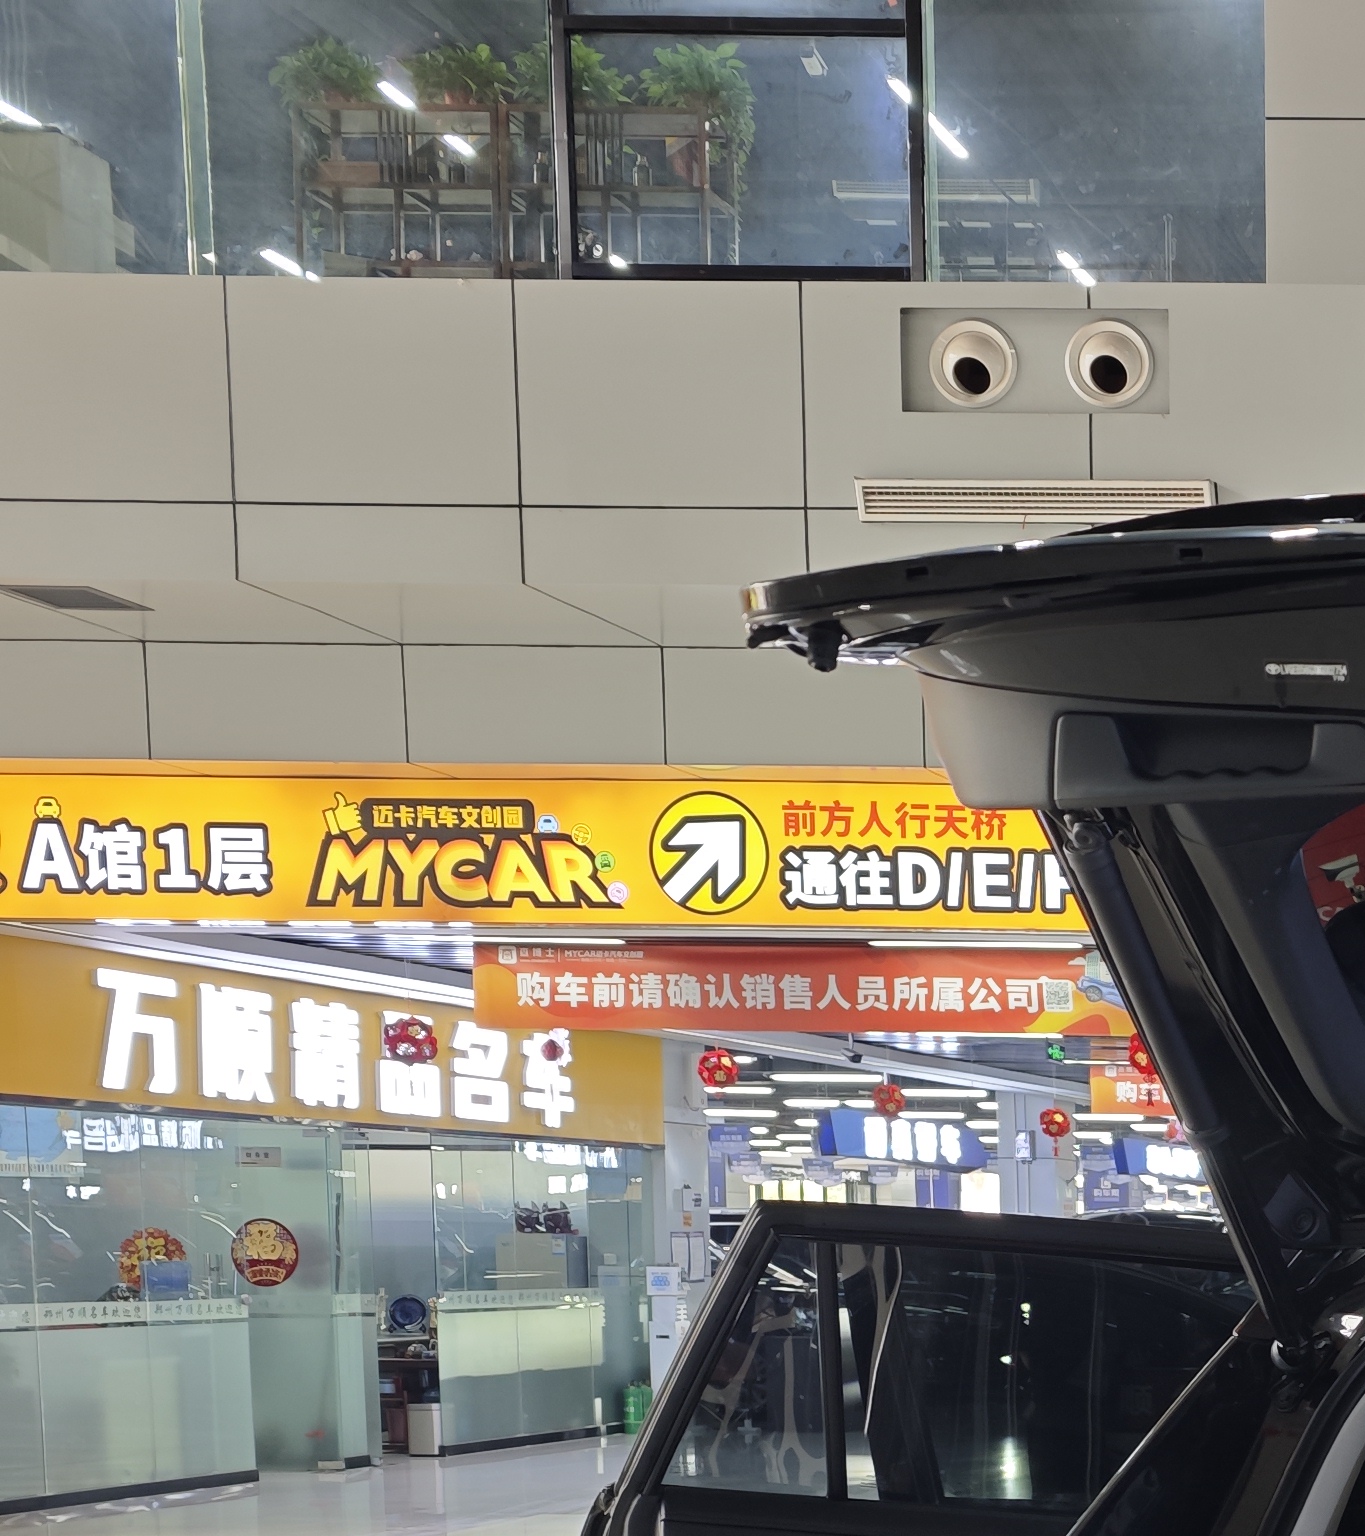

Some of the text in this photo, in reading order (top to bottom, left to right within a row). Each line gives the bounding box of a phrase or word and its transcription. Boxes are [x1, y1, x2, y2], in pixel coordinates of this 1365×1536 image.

[371, 804, 525, 830] 迈卡汽车文创园
[781, 800, 1007, 841] 前方人行天桥
[21, 822, 272, 893] A馆1层
[310, 834, 618, 907] MYCAR
[515, 971, 1043, 1014] 购车前请确认销售人员所属公司
[91, 967, 577, 1129] 万顺精品名车
[1116, 1081, 1170, 1104] 购车
